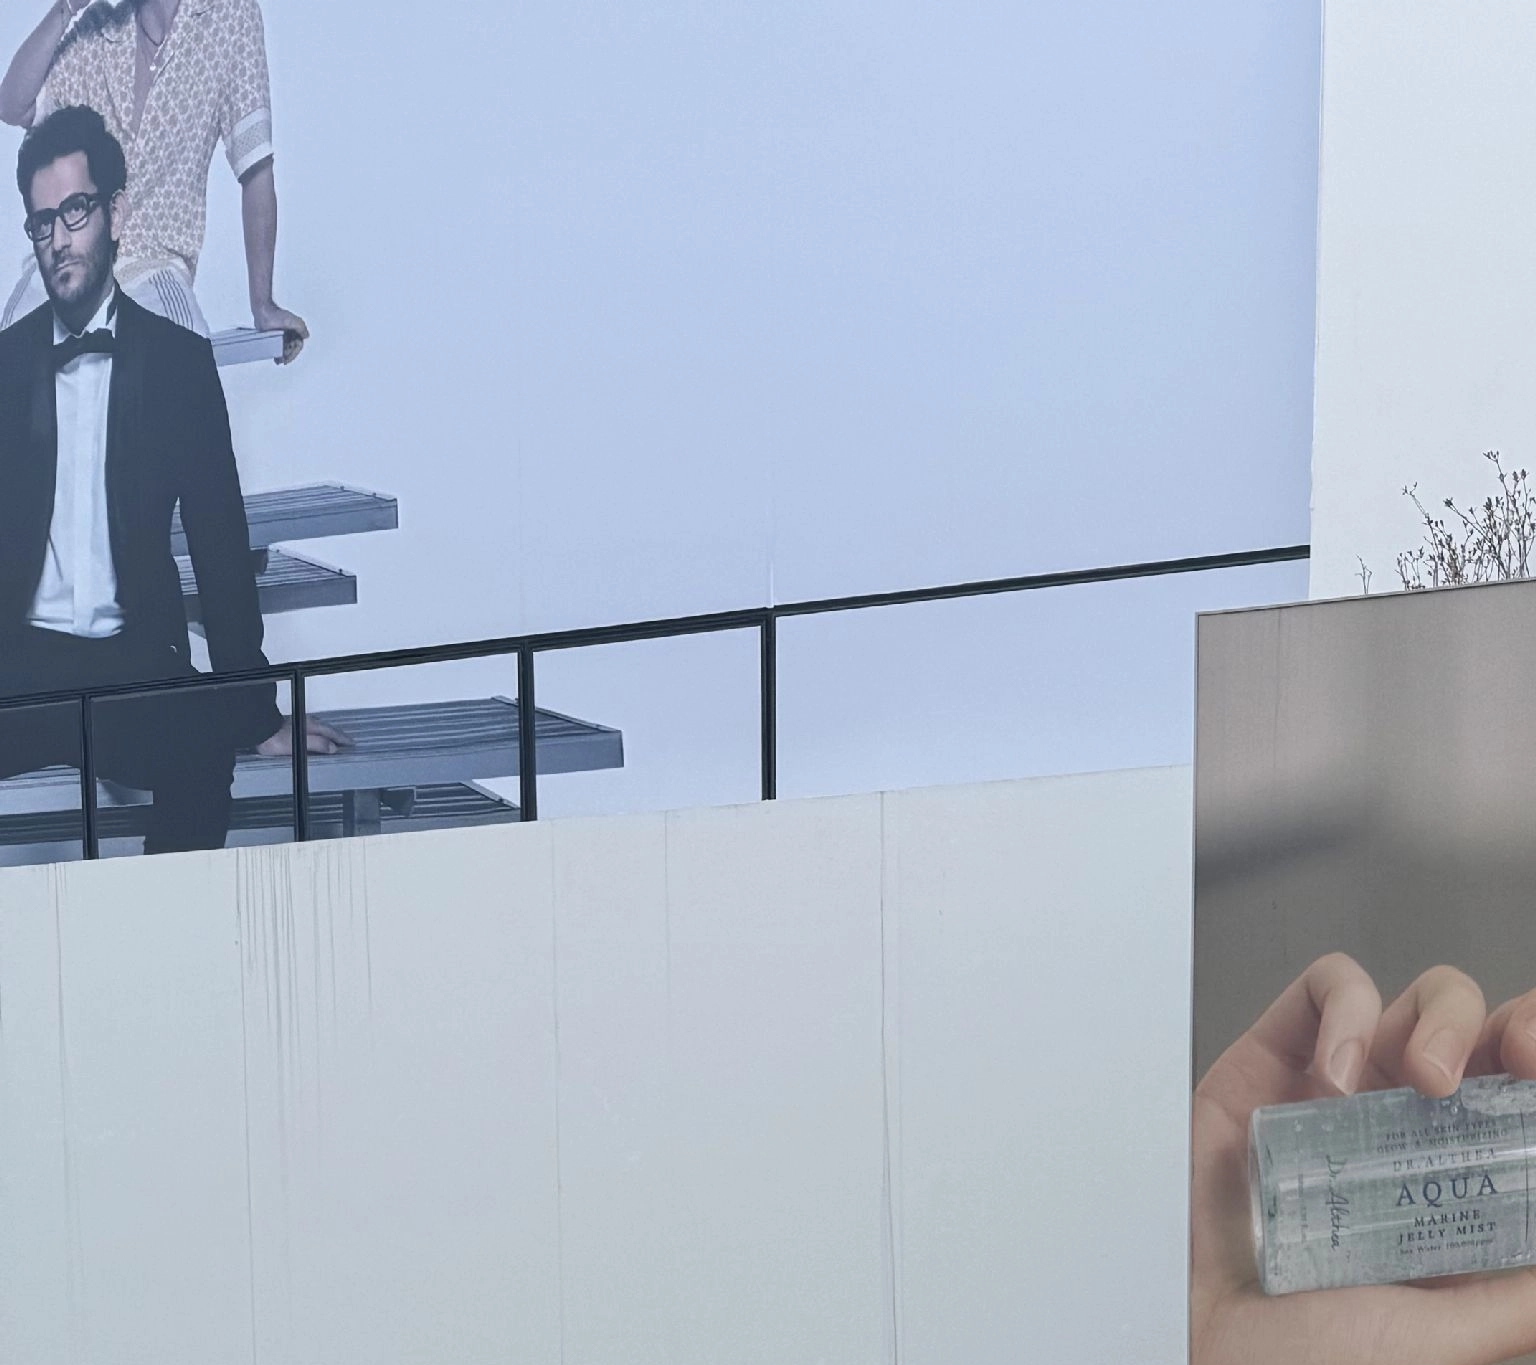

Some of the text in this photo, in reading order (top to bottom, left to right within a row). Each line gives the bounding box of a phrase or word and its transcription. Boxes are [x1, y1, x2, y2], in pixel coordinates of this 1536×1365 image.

[1396, 1173, 1499, 1208] AQUA
[1414, 1209, 1481, 1228] MARINE
[1398, 1221, 1497, 1246] JELLY MIST
